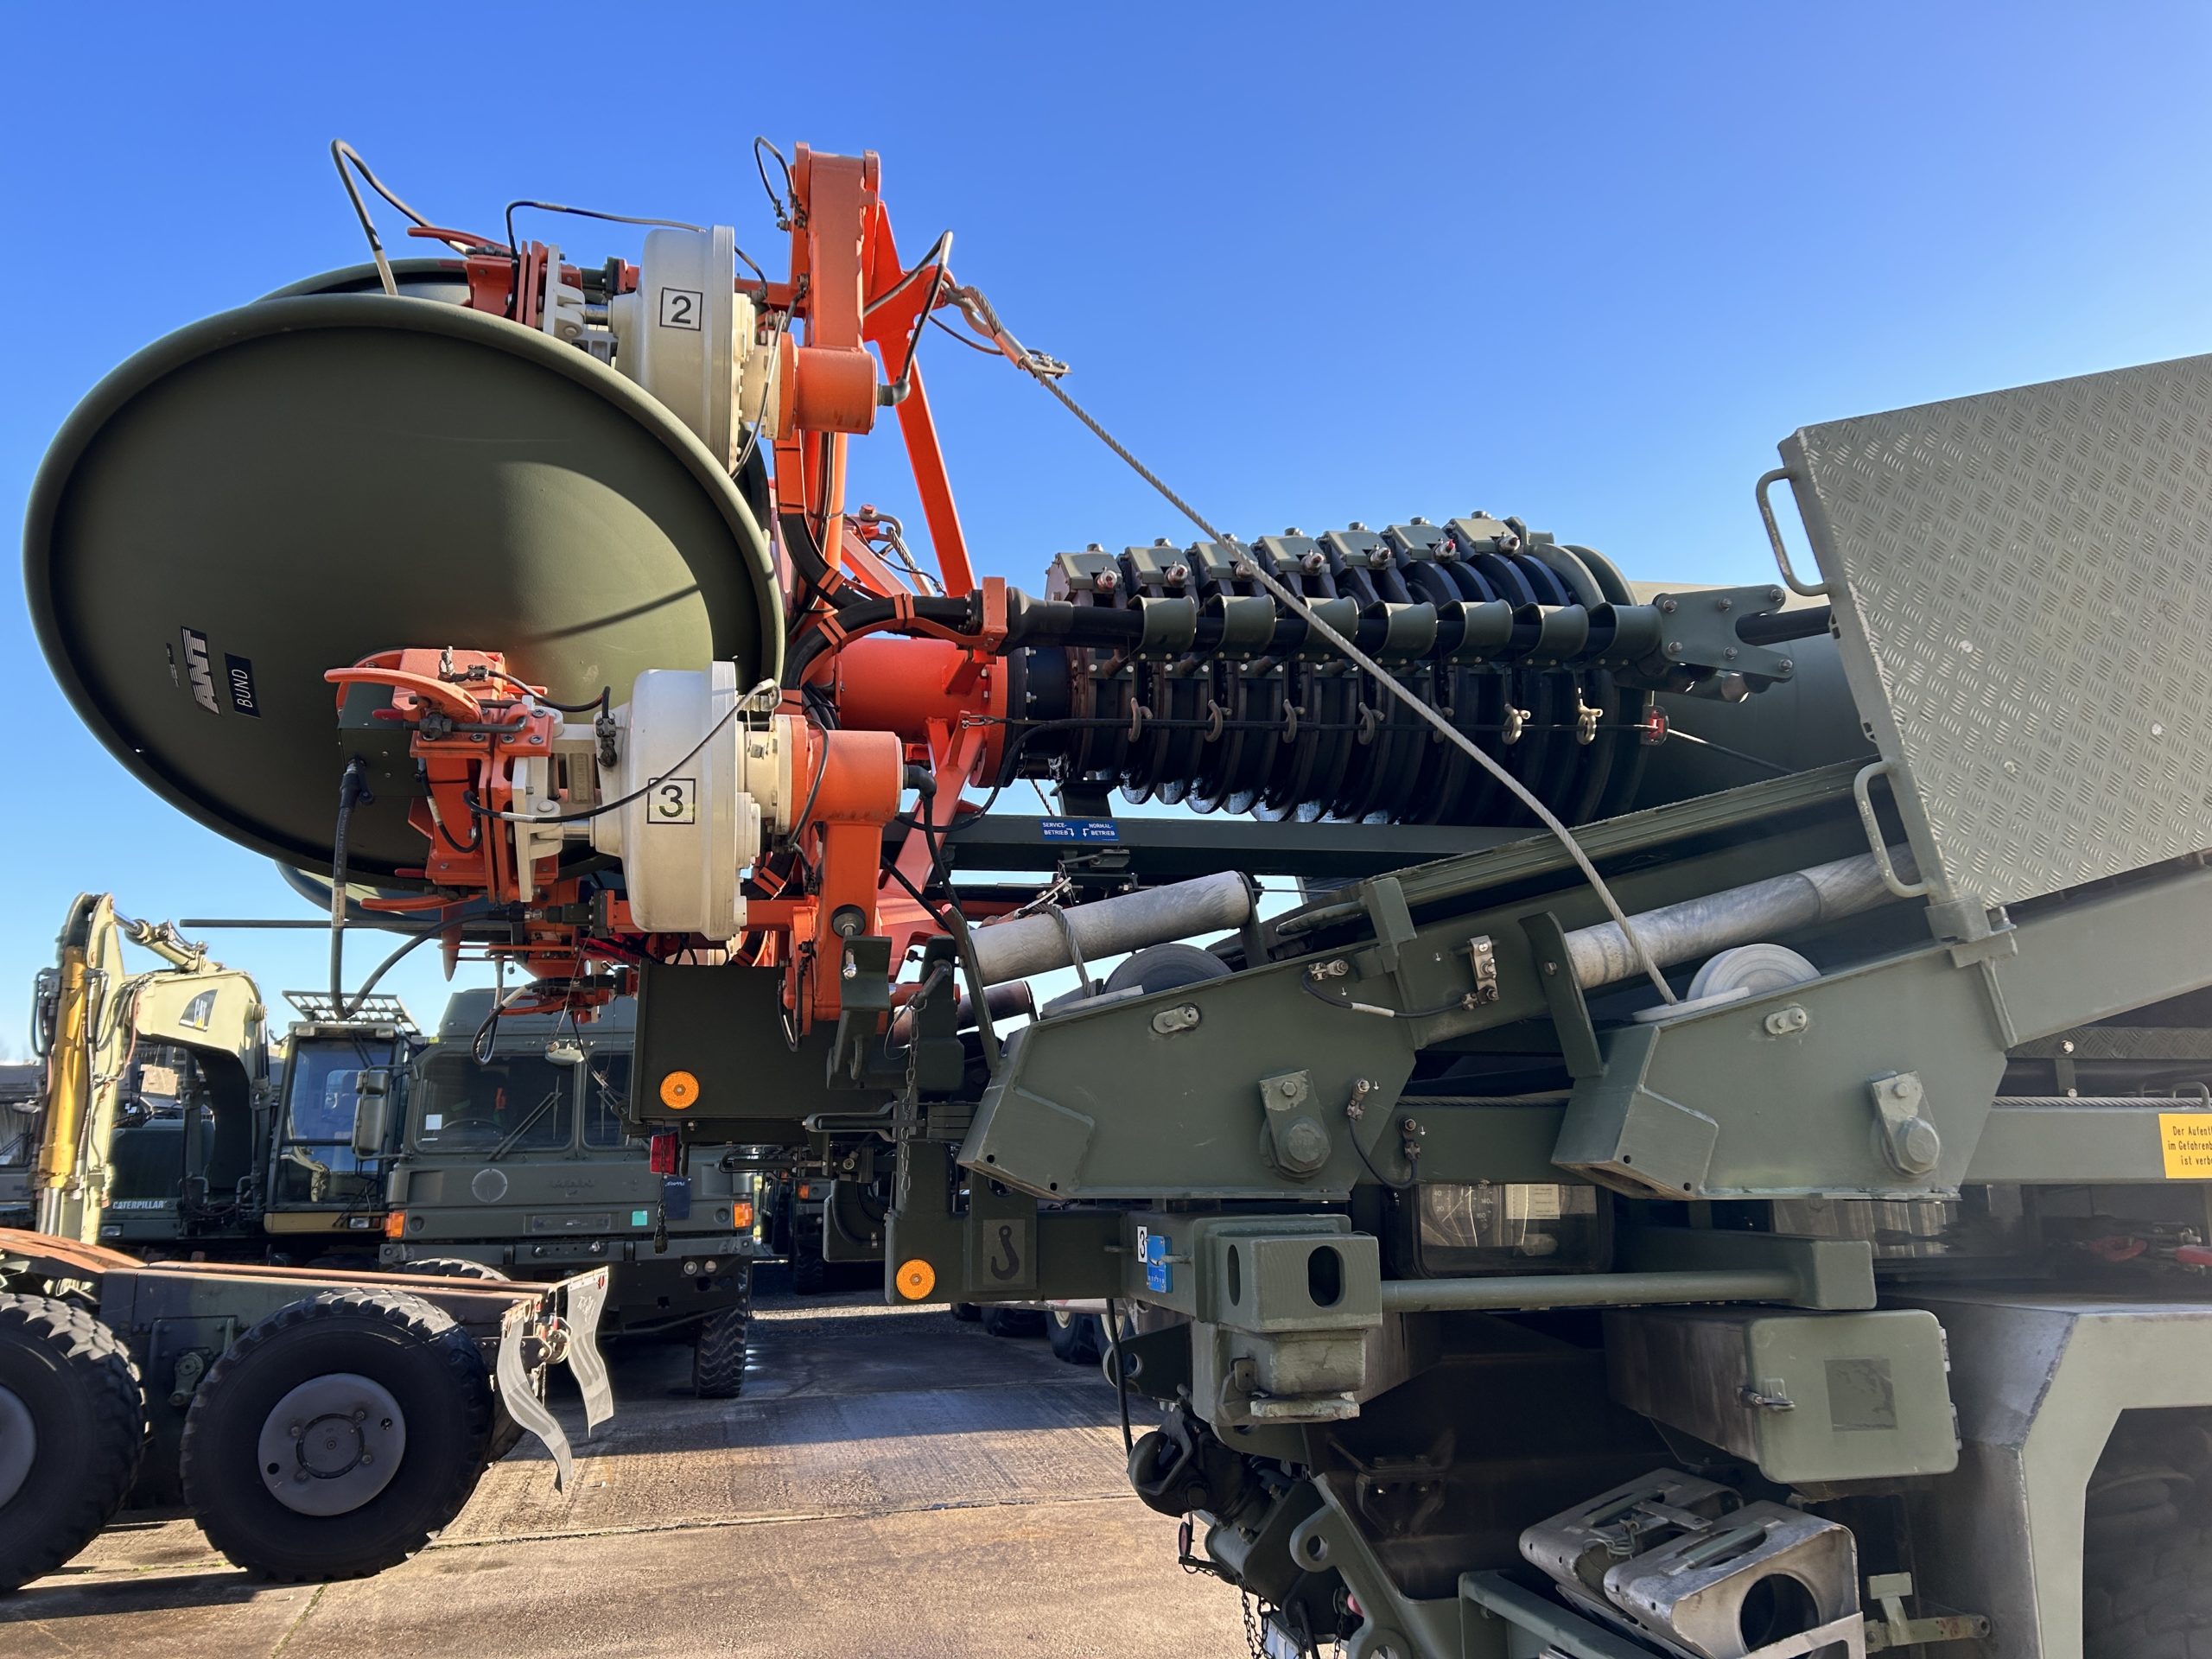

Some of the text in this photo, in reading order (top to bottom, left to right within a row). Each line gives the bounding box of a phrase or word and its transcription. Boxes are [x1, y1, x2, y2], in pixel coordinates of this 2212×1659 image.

[671, 295, 691, 325] 2
[181, 627, 220, 715] ANT
[231, 668, 253, 709] BUND
[658, 784, 684, 818] 3
[193, 997, 208, 1029] CAT
[2172, 1125, 2184, 1136] Der
[2167, 1140, 2177, 1151] im
[2180, 1154, 2192, 1166] ist
[112, 1199, 164, 1210] CATERPILLAR
[1140, 1230, 1146, 1259] 3
